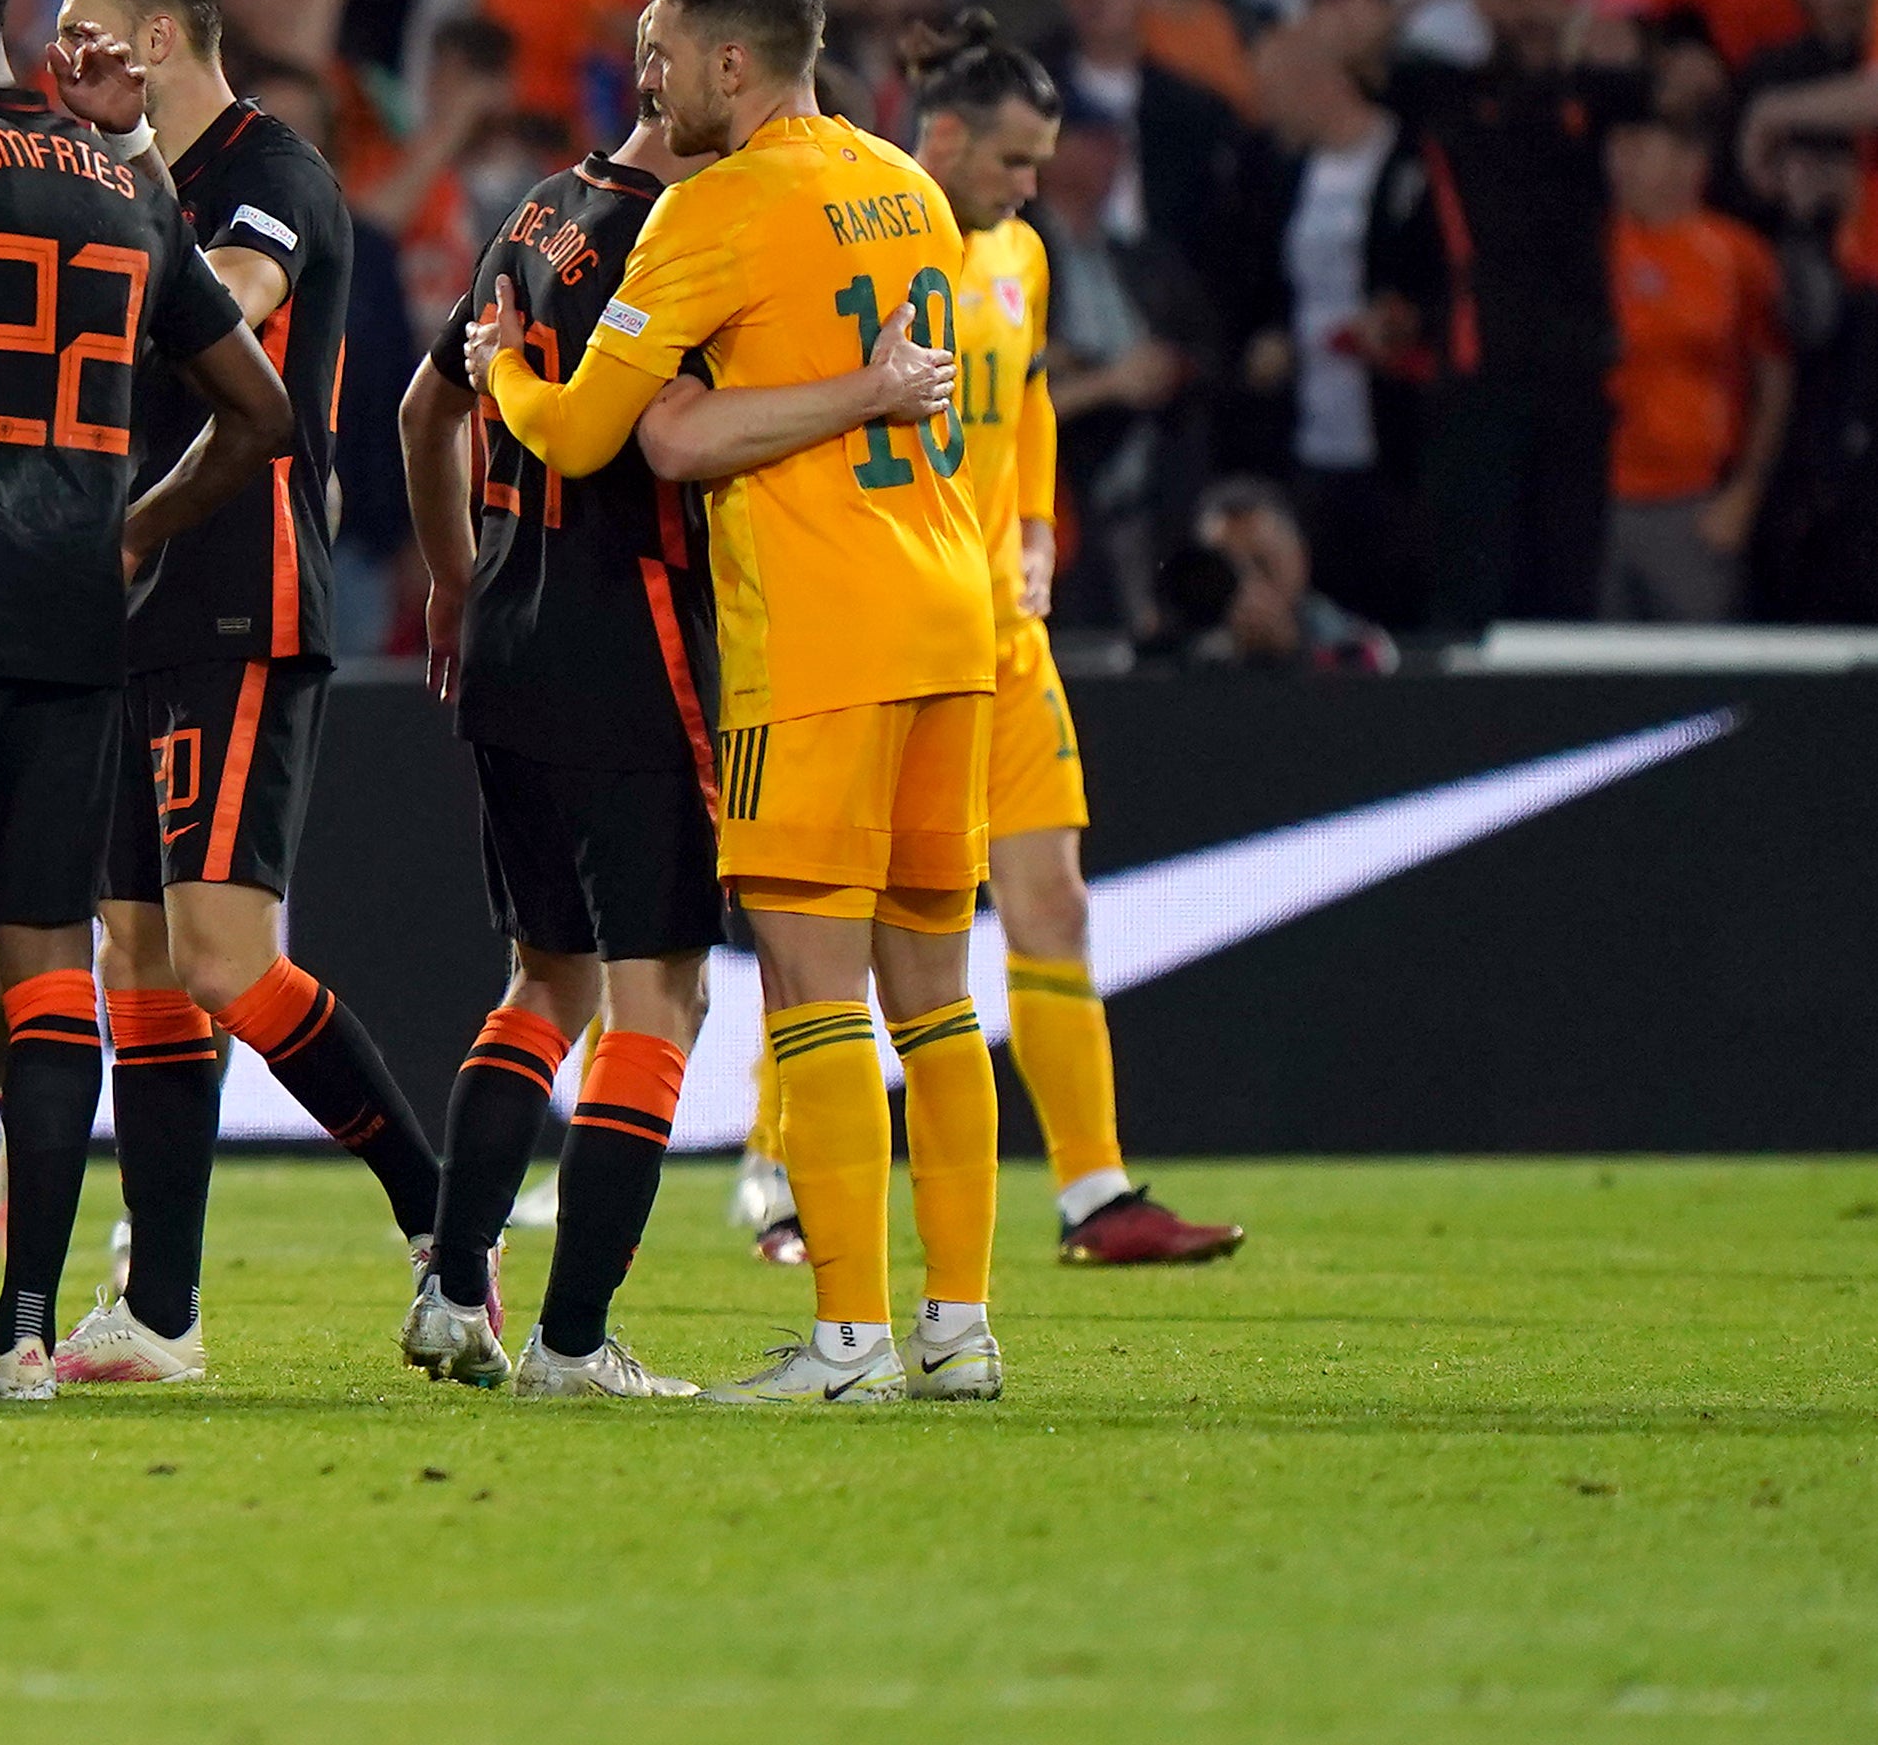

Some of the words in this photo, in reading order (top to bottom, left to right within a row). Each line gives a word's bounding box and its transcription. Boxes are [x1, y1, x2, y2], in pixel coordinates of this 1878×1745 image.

[510, 200, 557, 247] DE
[539, 218, 599, 286] JONG
[823, 192, 934, 246] RAMSEY
[835, 266, 966, 490] 10
